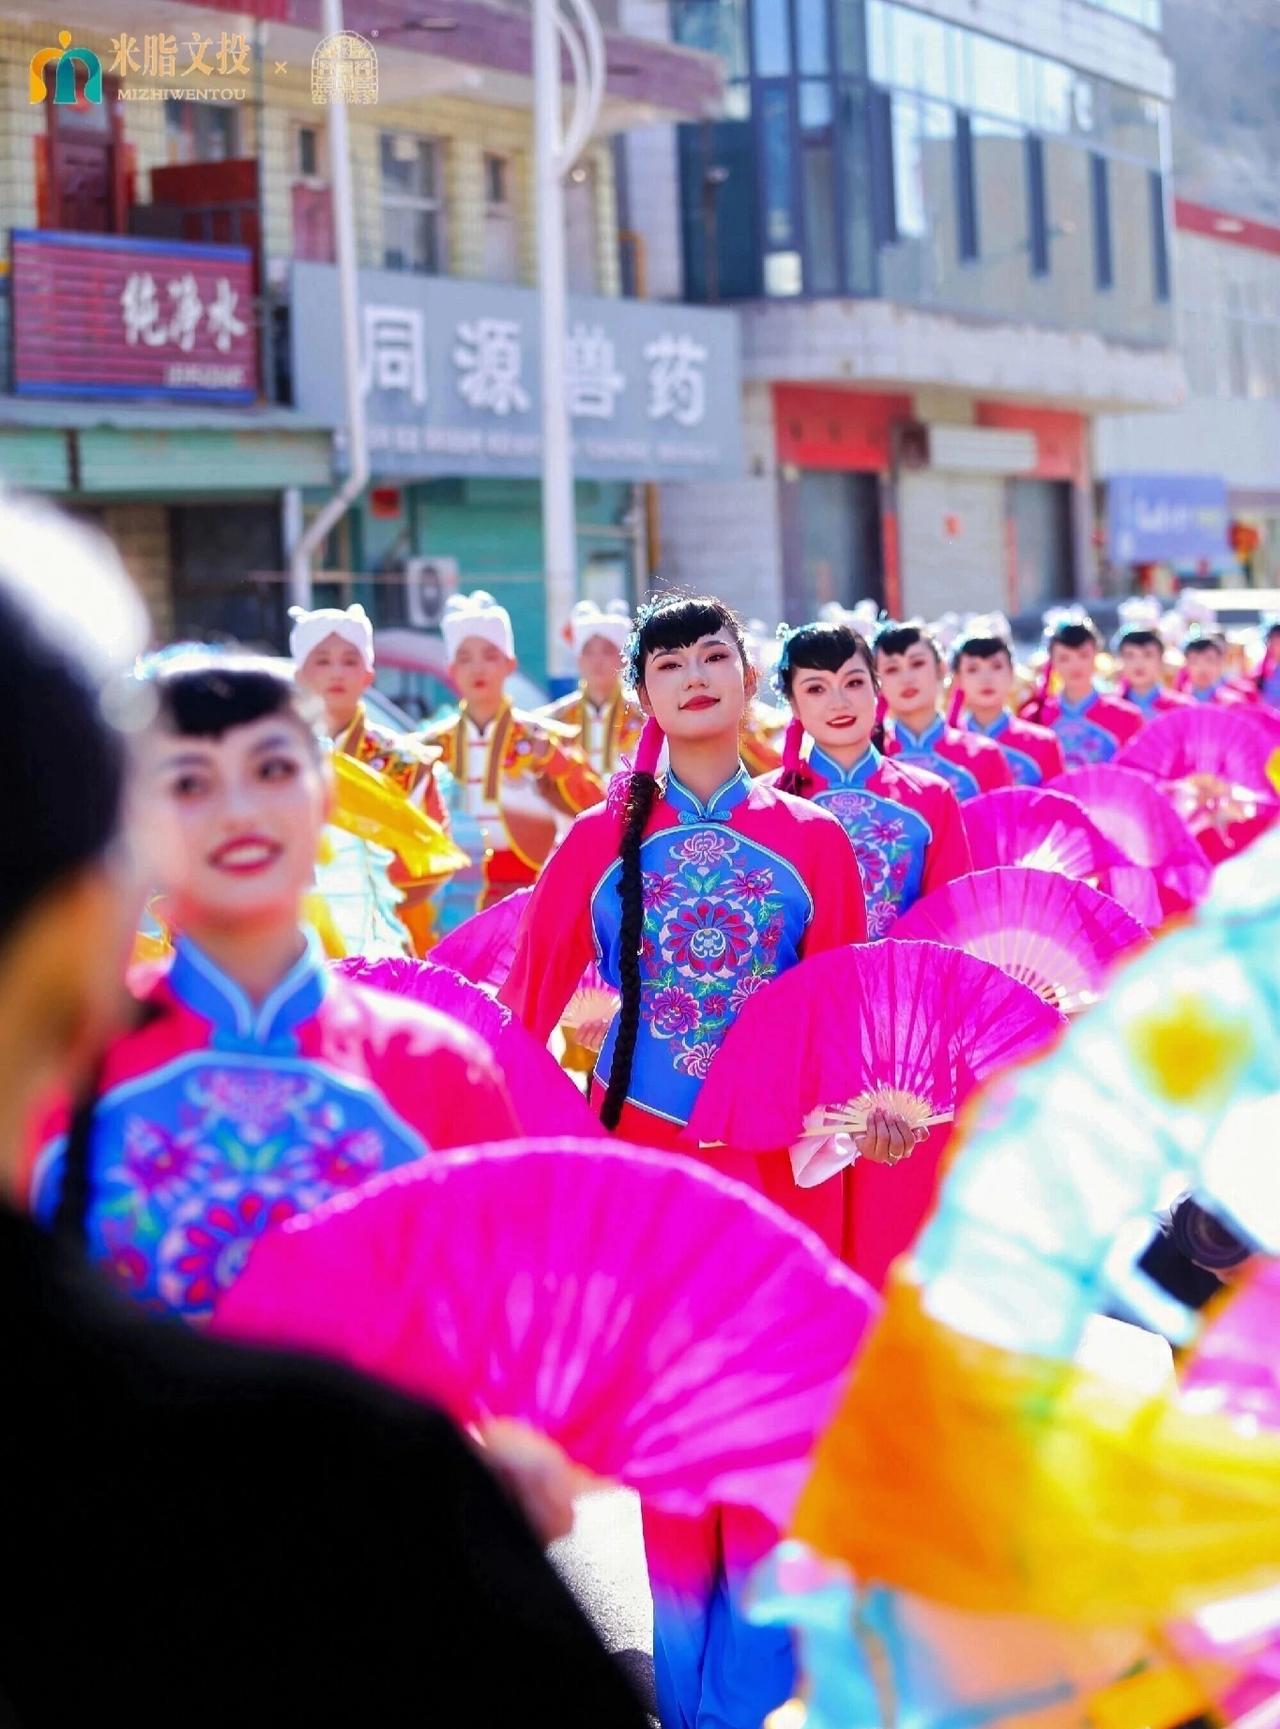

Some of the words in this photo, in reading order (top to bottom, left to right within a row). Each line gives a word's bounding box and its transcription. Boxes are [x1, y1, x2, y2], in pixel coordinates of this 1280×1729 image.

[121, 271, 247, 353] 纯净水
[358, 305, 707, 426] 同源兽药
